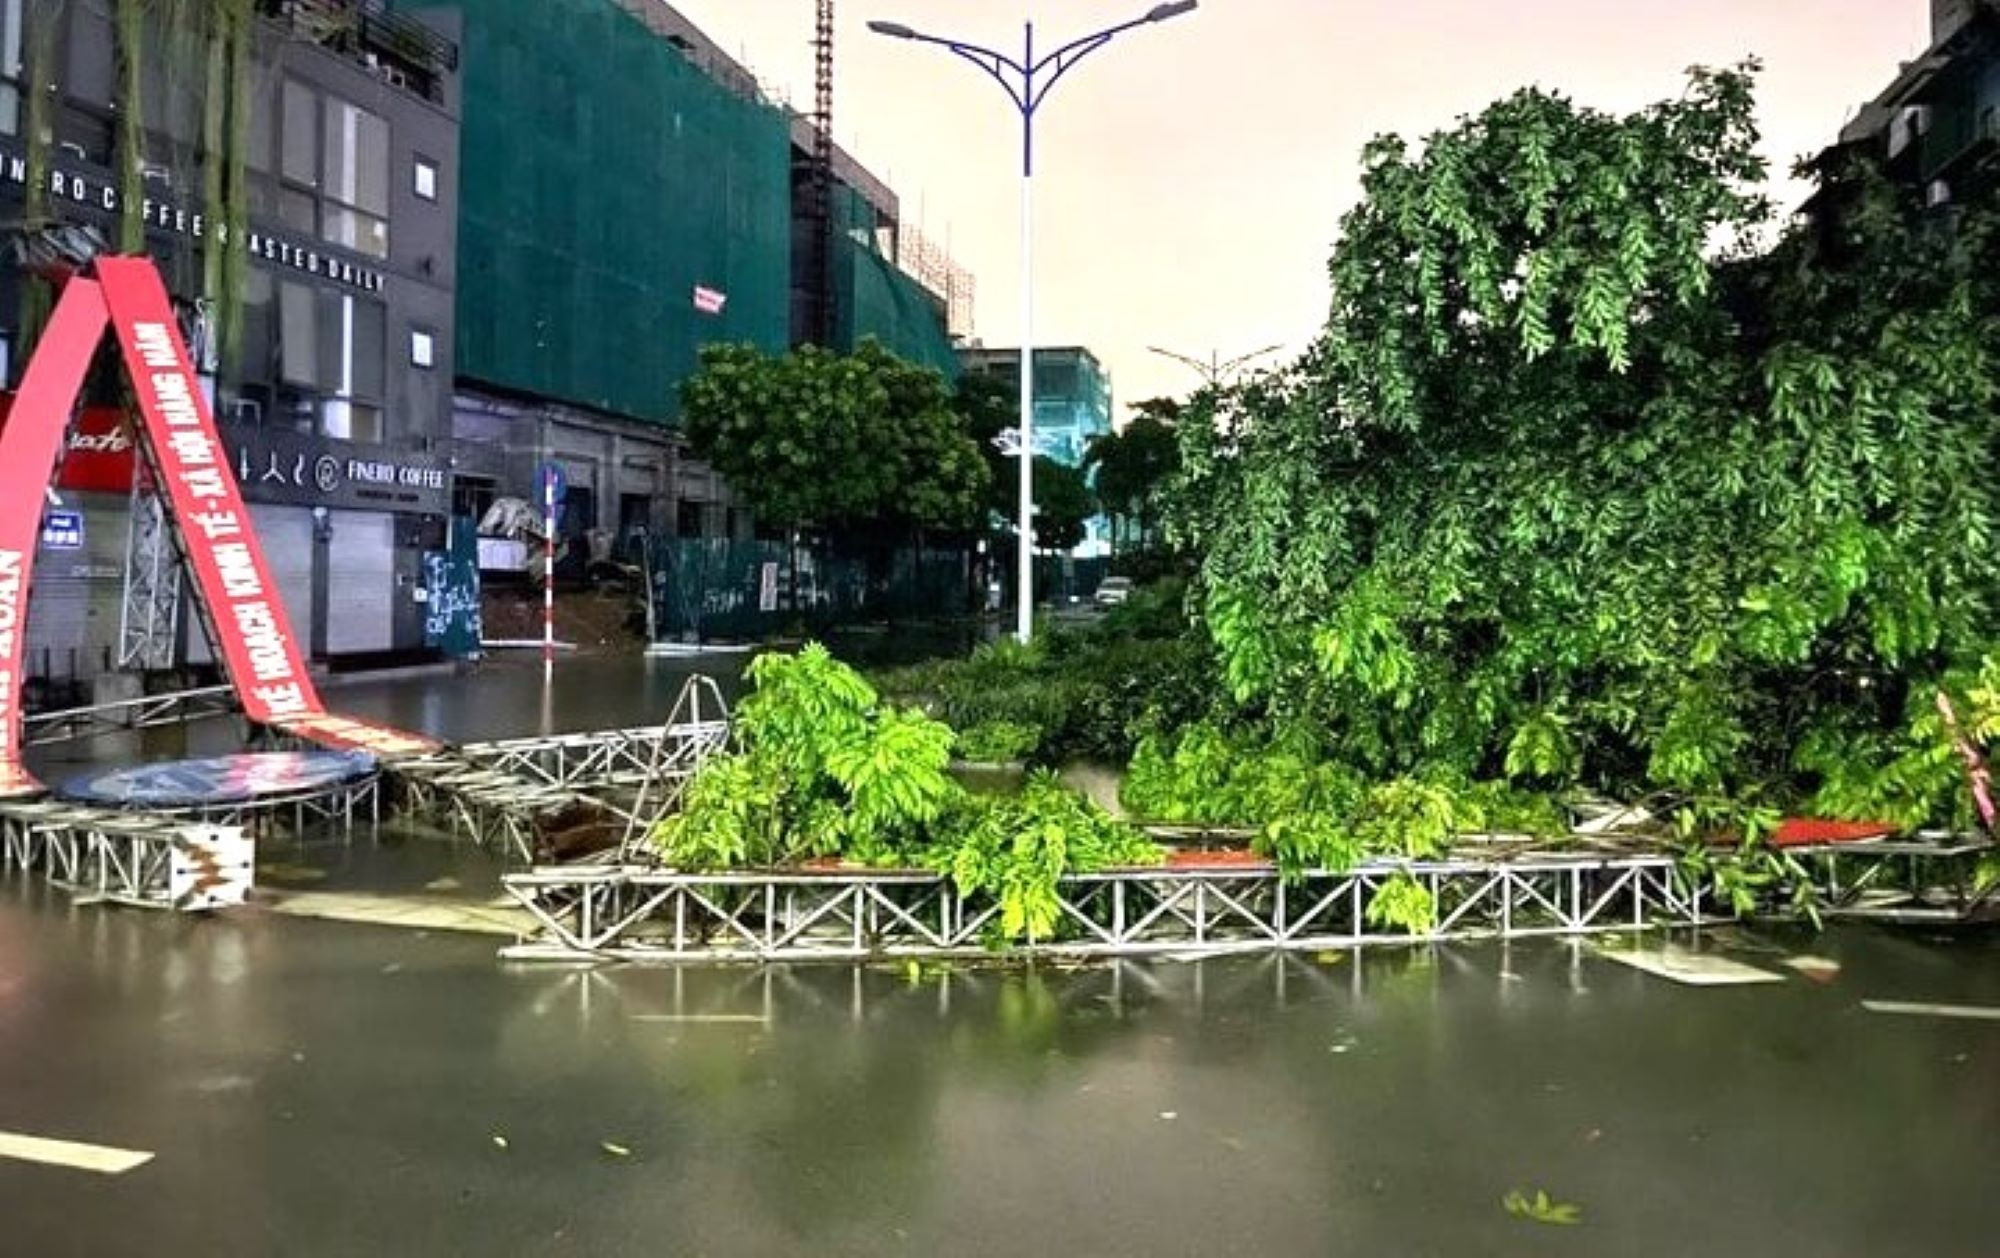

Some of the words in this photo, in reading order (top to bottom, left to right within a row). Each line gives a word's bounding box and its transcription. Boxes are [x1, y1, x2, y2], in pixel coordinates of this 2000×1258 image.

[104, 187, 202, 236] CFFEE
[217, 222, 319, 272] RASTED
[328, 258, 384, 291] DAILY
[399, 466, 444, 489] COFFEE
[210, 542, 263, 597] KINH
